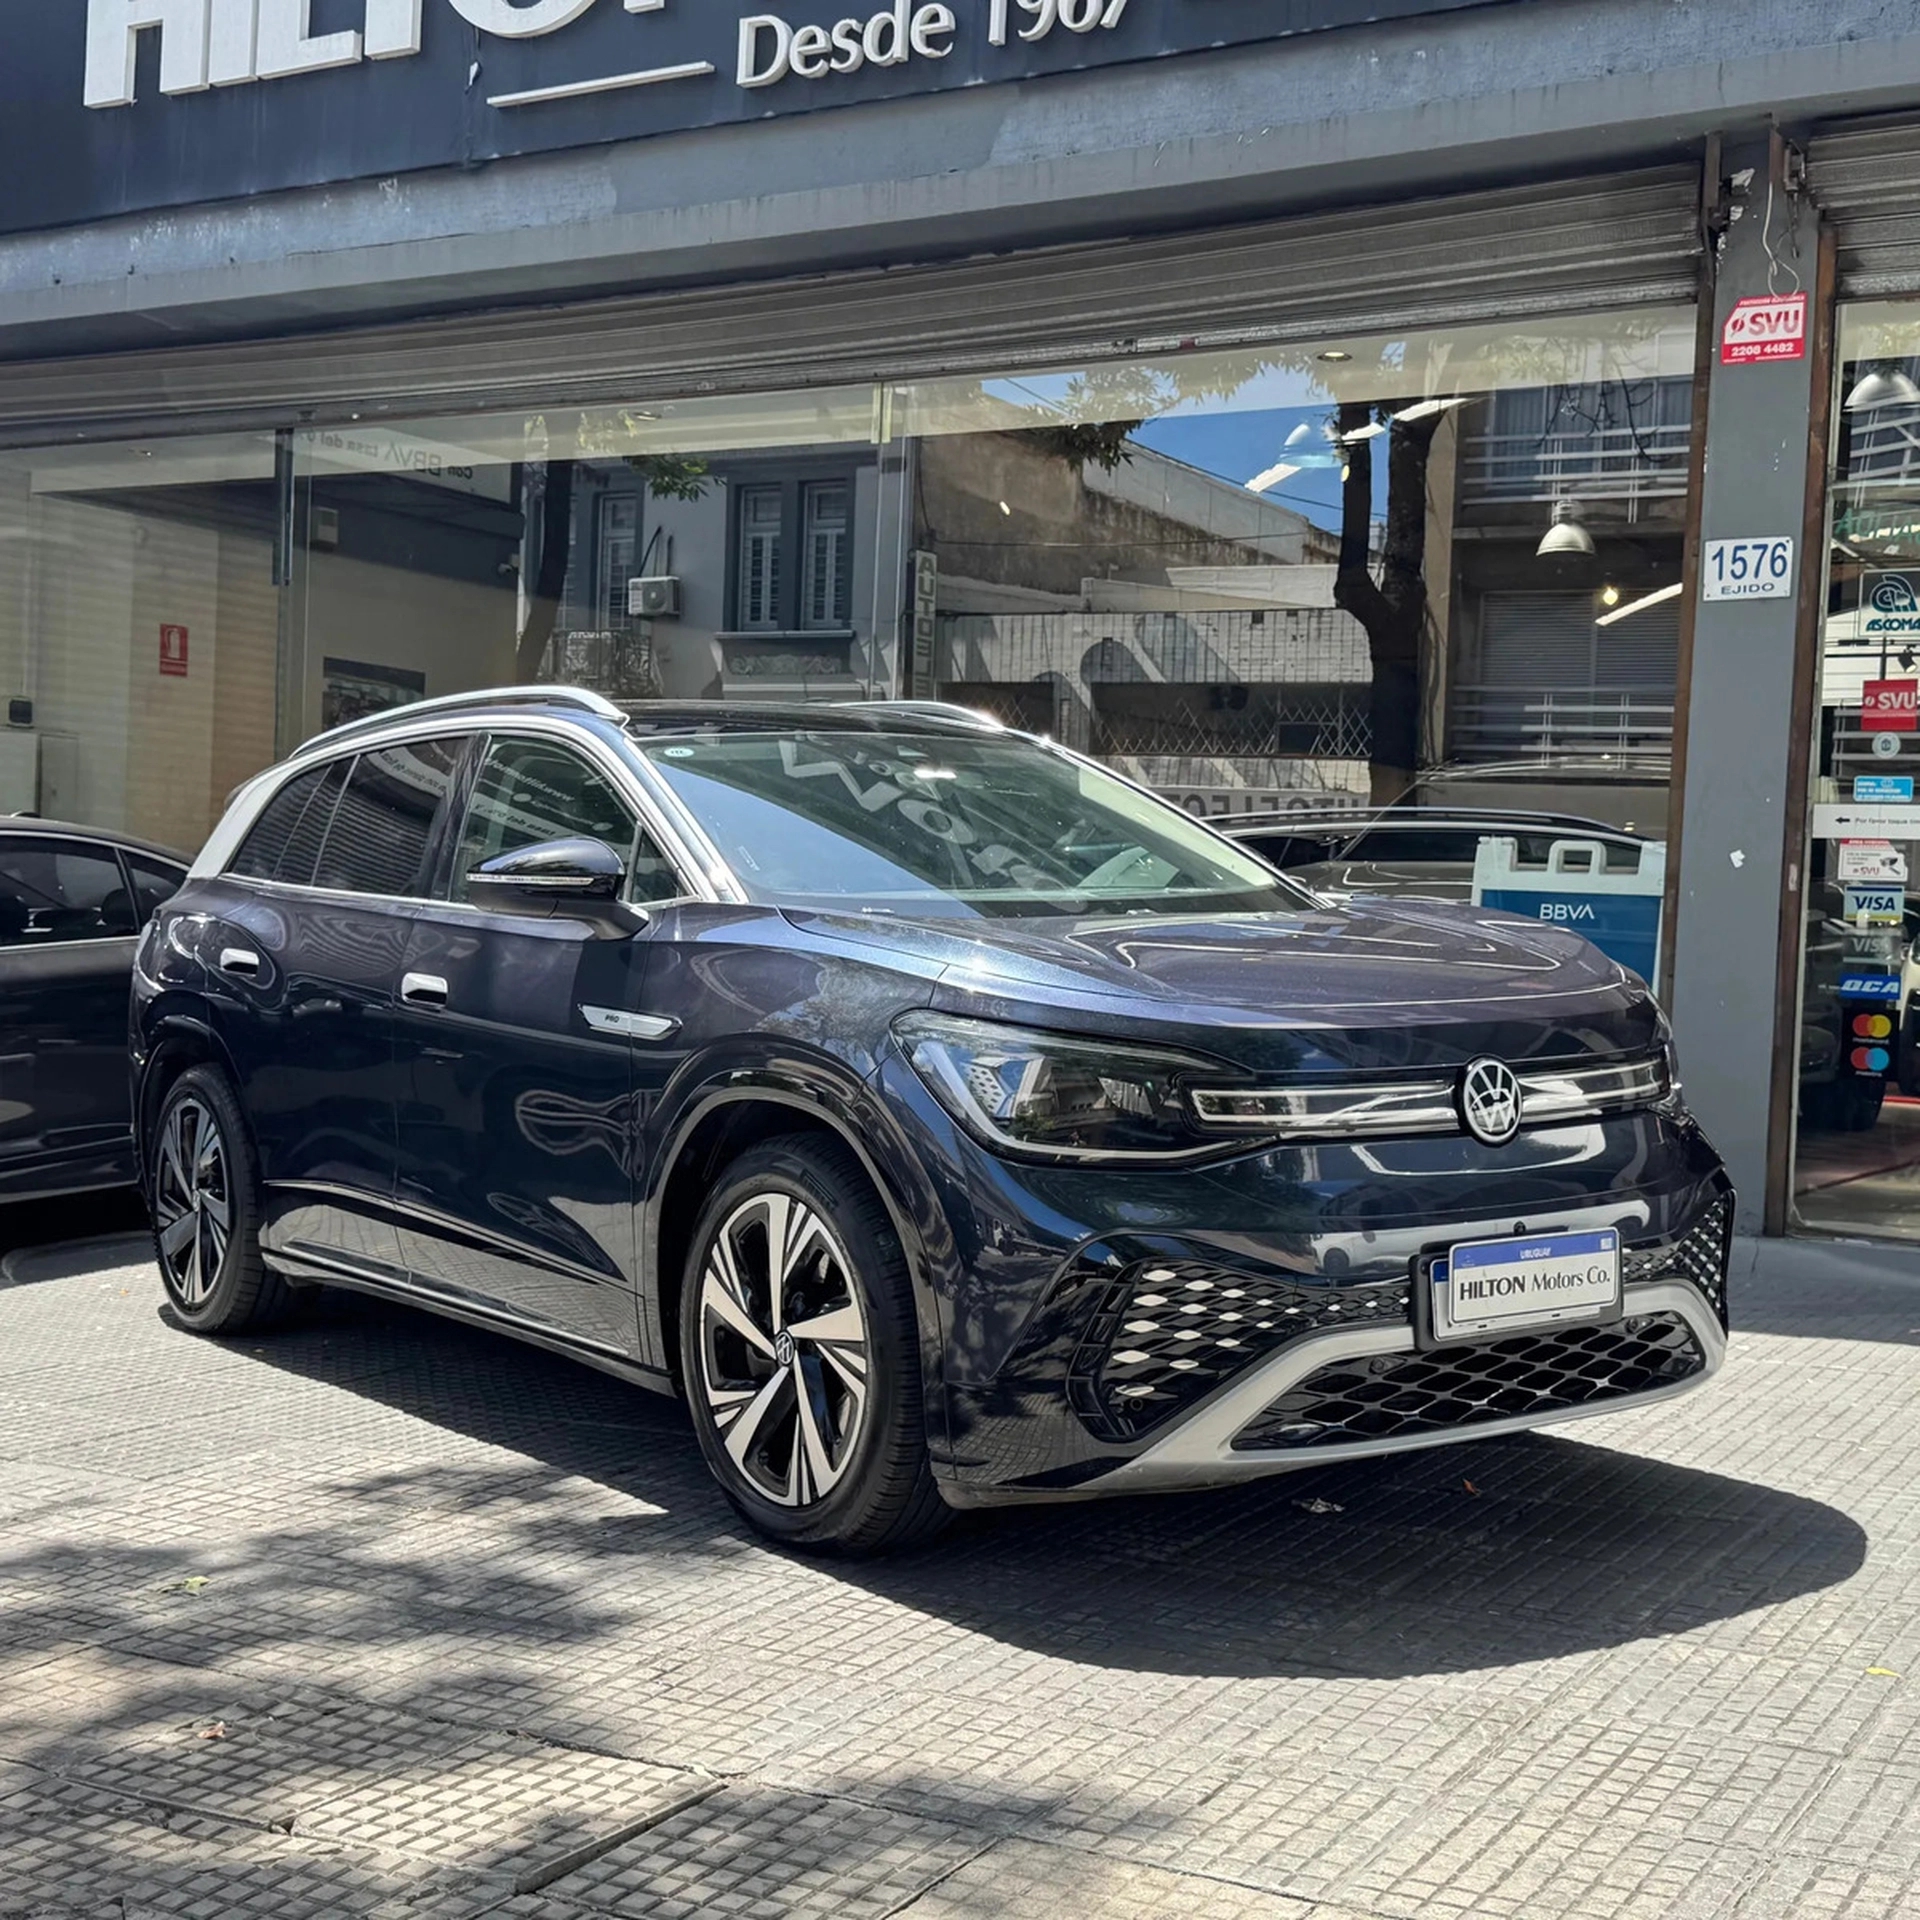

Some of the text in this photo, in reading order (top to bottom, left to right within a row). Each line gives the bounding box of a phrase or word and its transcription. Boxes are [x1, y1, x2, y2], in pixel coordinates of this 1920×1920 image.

[736, 0, 956, 89] Desde
[1748, 309, 1799, 336] SVU
[1712, 542, 1787, 581] 1576
[1721, 582, 1775, 595] EJIDO
[1877, 691, 1916, 710] SVU
[1540, 903, 1595, 920] BBVA
[1853, 895, 1895, 911] VISA
[1460, 1265, 1611, 1301] HILTON Motors Co.
